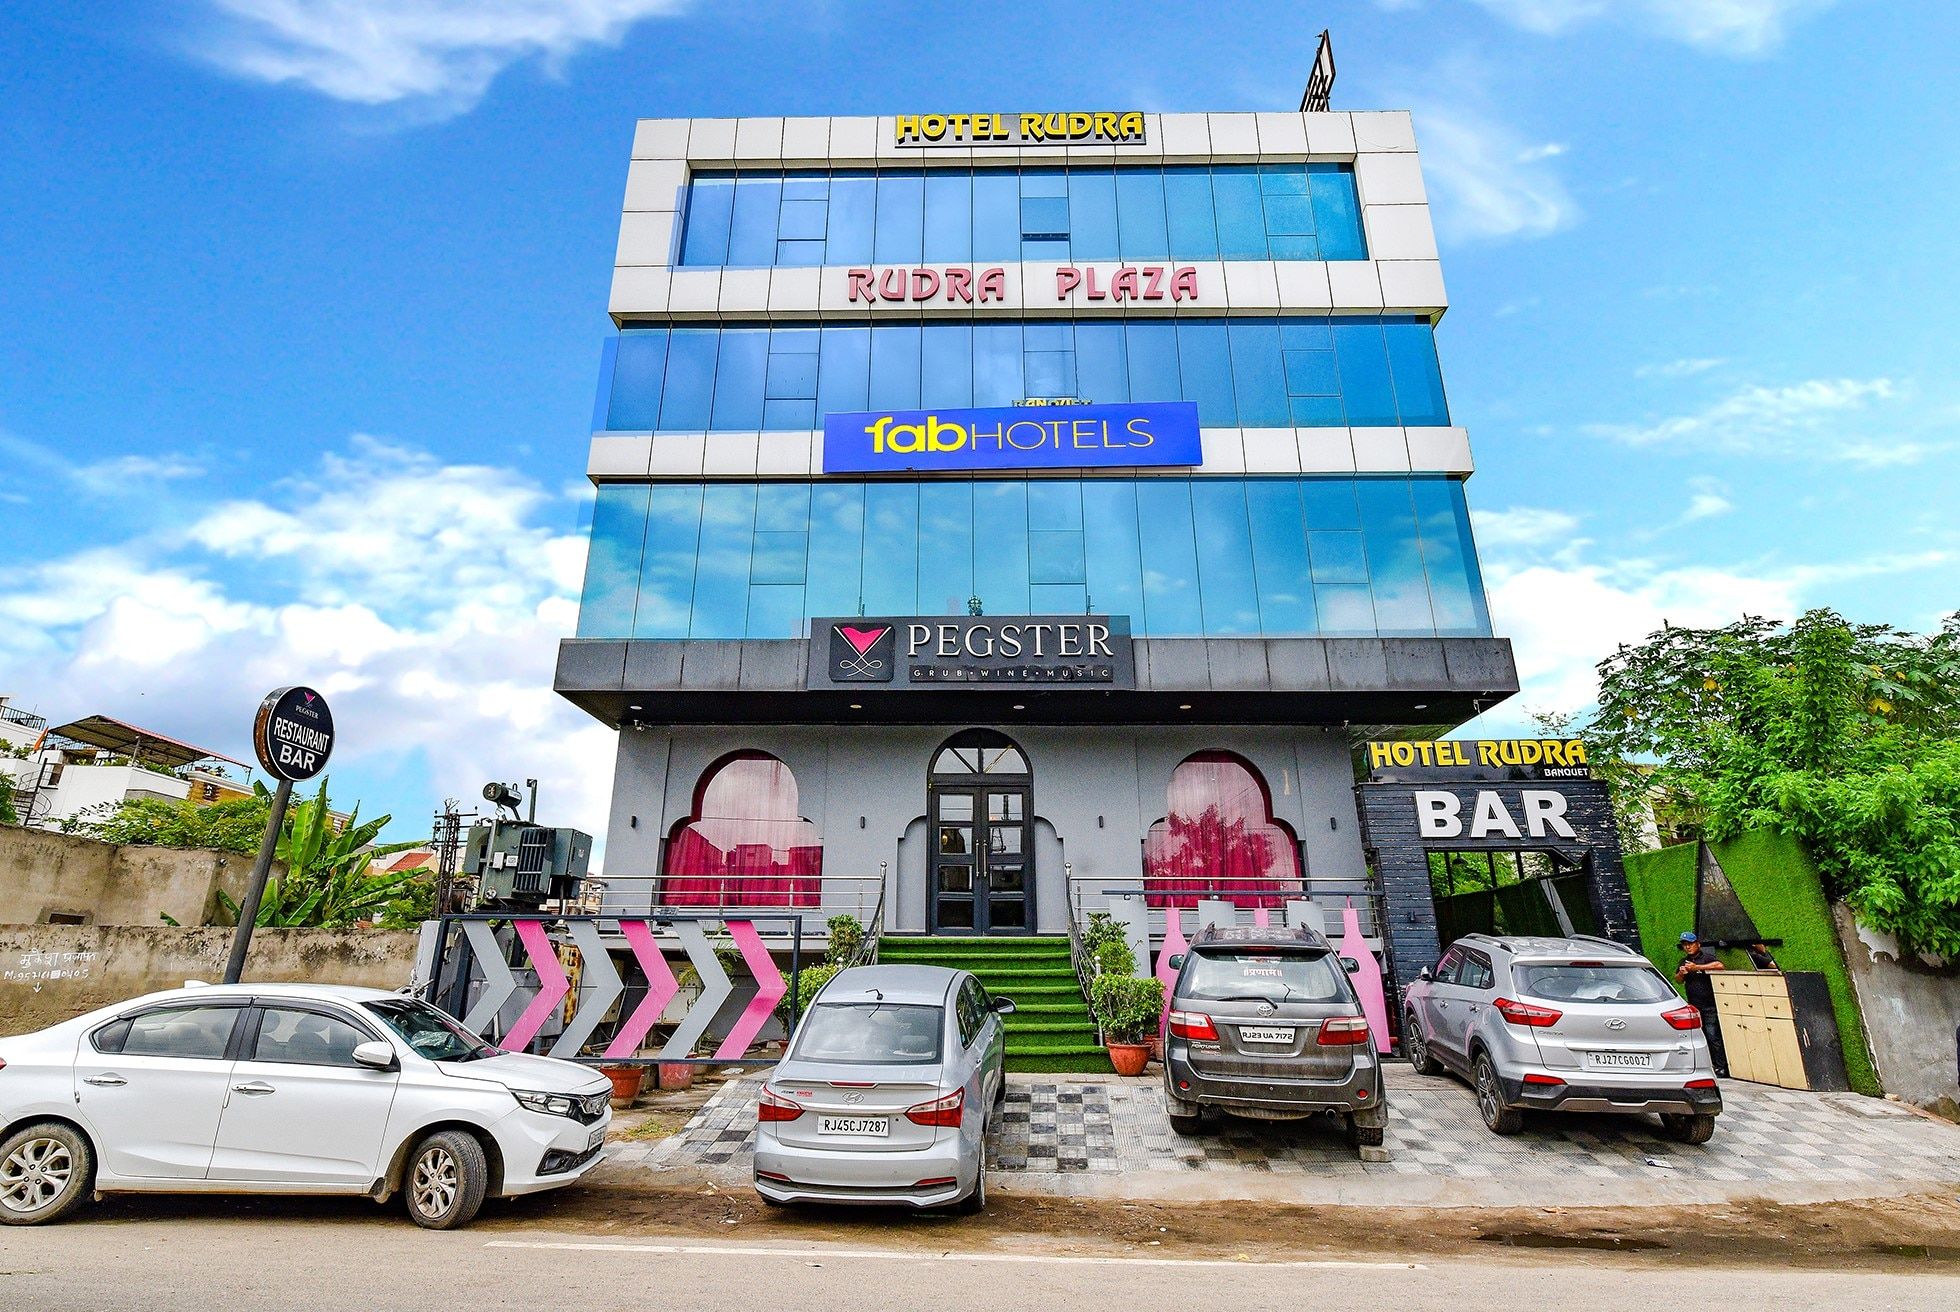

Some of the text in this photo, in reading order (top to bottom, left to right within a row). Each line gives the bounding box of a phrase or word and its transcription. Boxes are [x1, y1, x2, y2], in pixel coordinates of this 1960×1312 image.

[896, 112, 1144, 144] HOTEL RUDRA
[848, 266, 1198, 304] RUDRA PLAZA
[907, 624, 1114, 657] PEGSTER
[980, 669, 1028, 678] WINE
[1046, 669, 1109, 678] MUSIC
[295, 704, 319, 720] PEGSTER
[273, 716, 330, 753] RESTAURANT
[279, 744, 316, 772] BAR
[1371, 740, 1588, 769] HOTEL RUDRA
[1544, 768, 1589, 777] BANQUET
[1414, 790, 1578, 838] BAR
[1275, 1032, 1293, 1040] 7172
[824, 1119, 887, 1132] RJ45CJ7287
